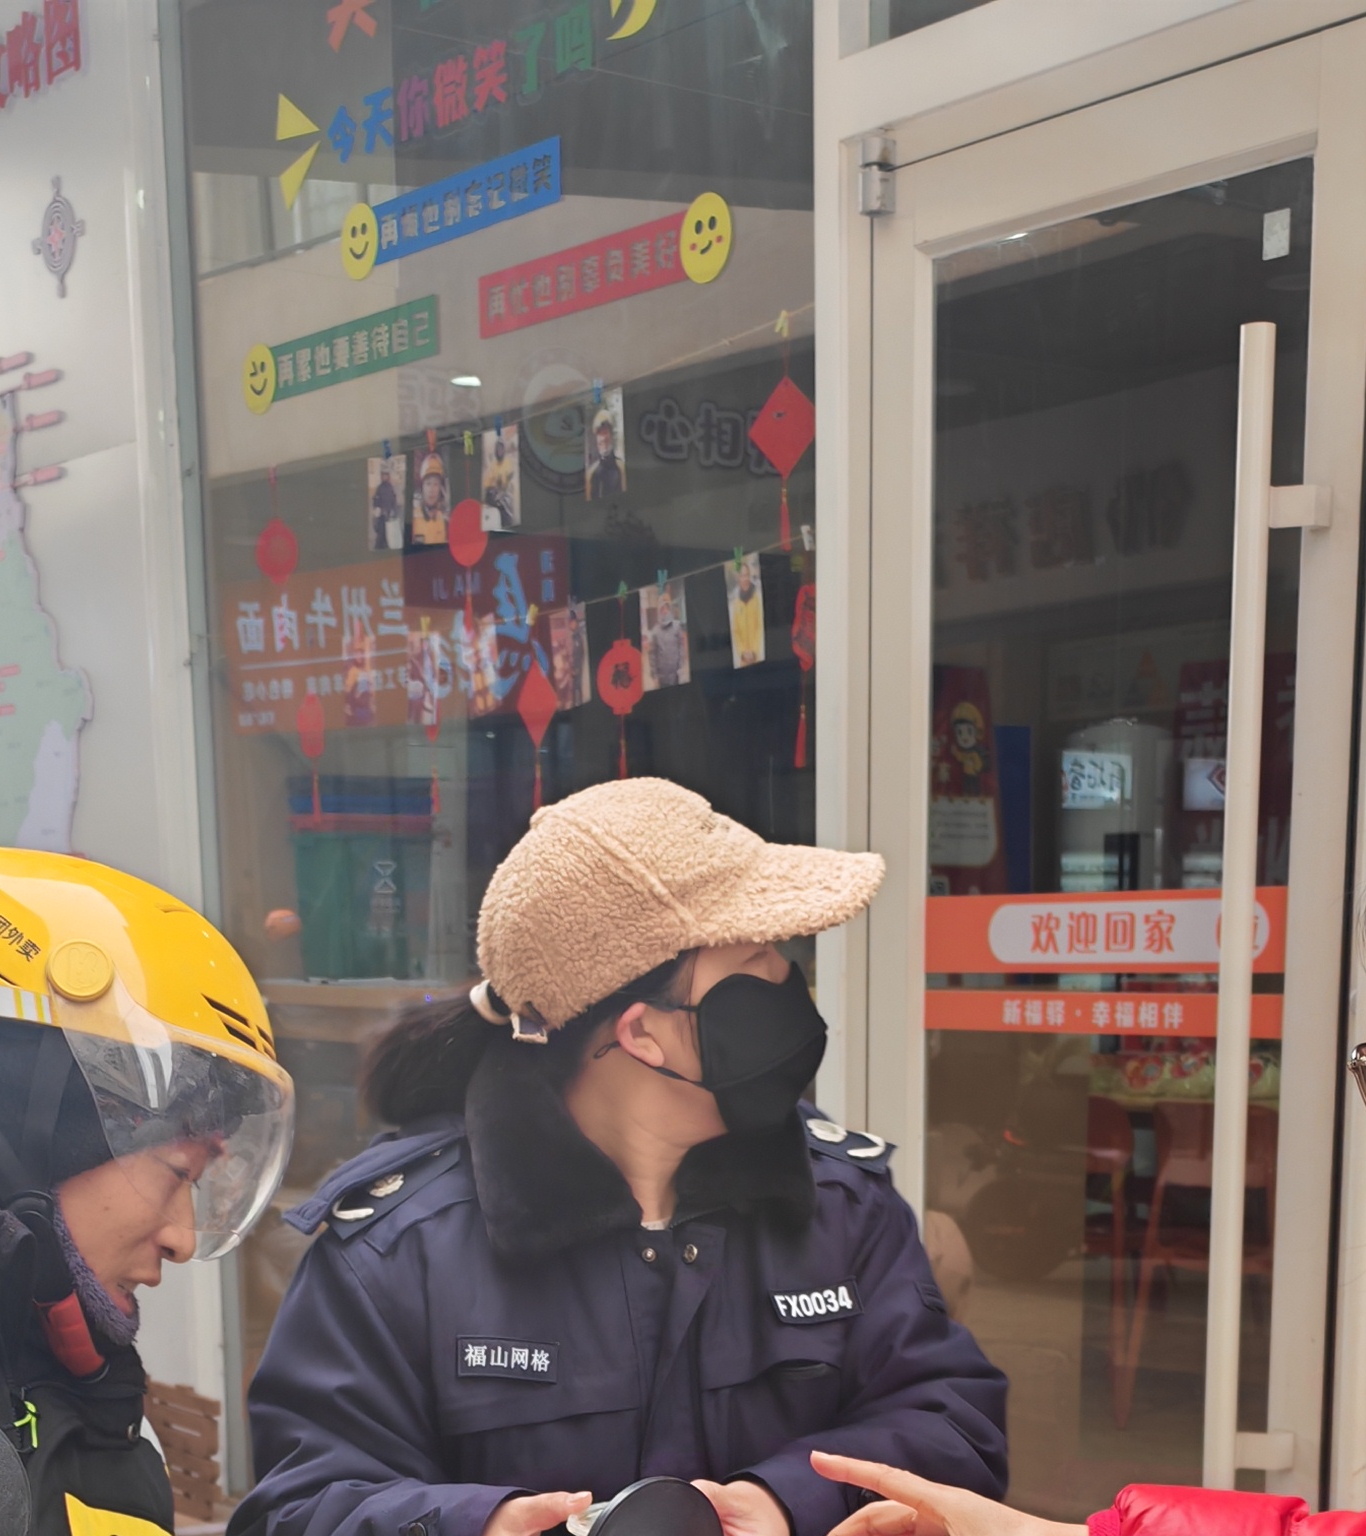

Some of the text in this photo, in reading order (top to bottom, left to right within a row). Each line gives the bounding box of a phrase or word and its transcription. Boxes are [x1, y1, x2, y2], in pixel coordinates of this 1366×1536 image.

[327, 5, 595, 163] 今天你微笑了吗
[277, 310, 431, 389] 再累也要善待自己
[1030, 908, 1177, 955] 欢迎回家
[1002, 998, 1184, 1030] 新福驿·幸福相伴
[773, 1285, 854, 1319] FX0034
[463, 1343, 550, 1373] 福山网格
